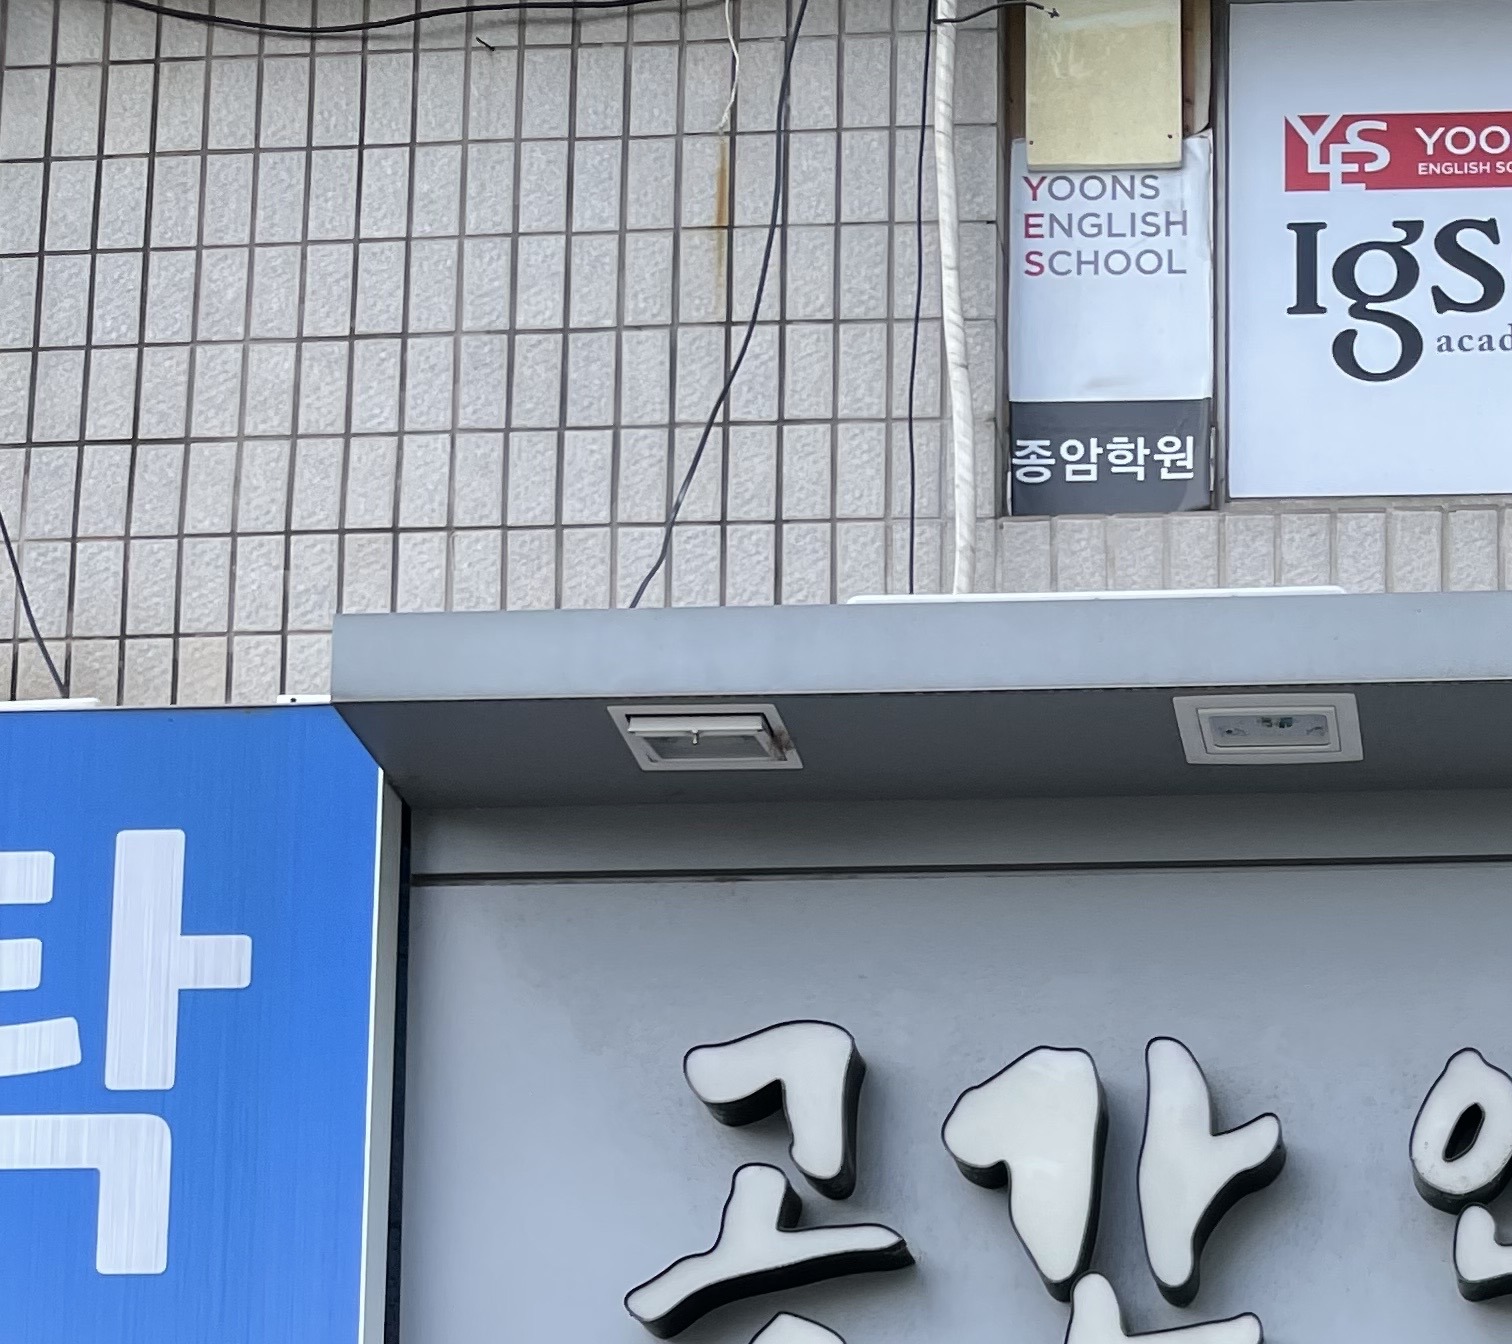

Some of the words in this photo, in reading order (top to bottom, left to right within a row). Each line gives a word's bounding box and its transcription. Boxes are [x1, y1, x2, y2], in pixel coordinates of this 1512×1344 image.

[1417, 160, 1491, 176] ENGLISH
[1022, 174, 1161, 202] YOONS
[1023, 210, 1190, 241] ENGLISH
[1024, 247, 1188, 279] SCHOOL
[1011, 433, 1196, 484] 종암학원
